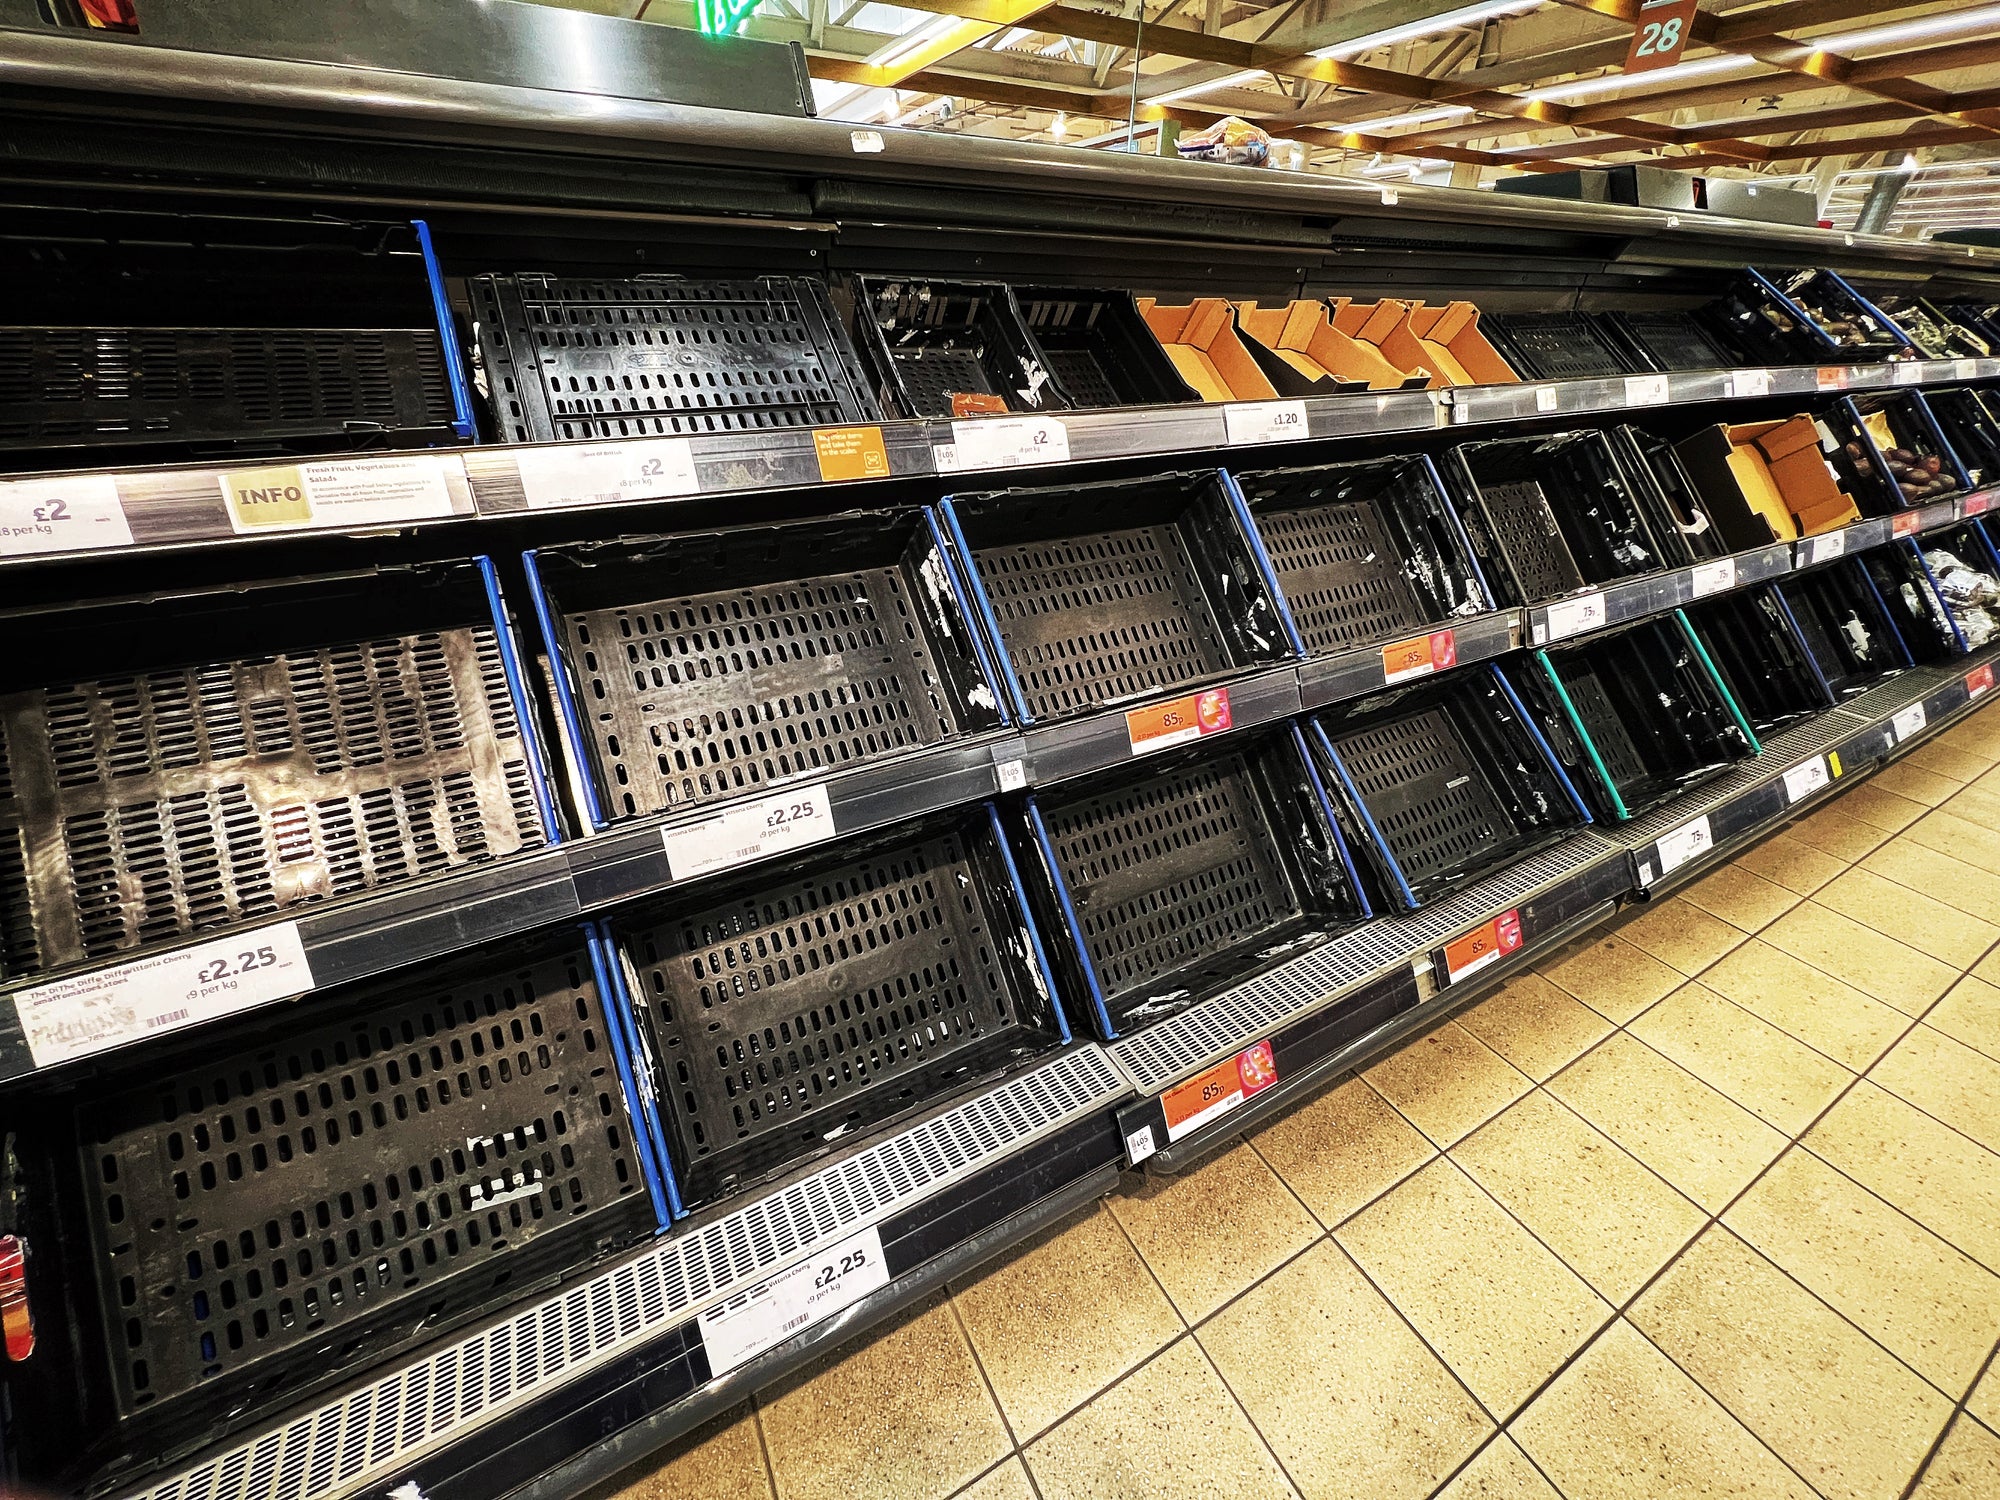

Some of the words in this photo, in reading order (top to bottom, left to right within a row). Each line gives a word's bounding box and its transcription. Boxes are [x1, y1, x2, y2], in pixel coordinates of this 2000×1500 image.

[1636, 17, 1683, 58] 28
[1274, 413, 1298, 425] £1.20
[1033, 431, 1048, 444] £2
[641, 458, 664, 476] £2
[238, 486, 301, 505] INFO
[33, 498, 72, 521] £2
[12, 527, 33, 537] per
[35, 524, 52, 535] kg
[1163, 712, 1183, 728] 85p
[767, 801, 814, 827] £2.25
[768, 827, 780, 837] per
[781, 825, 790, 834] kg
[198, 946, 277, 984] £2.25
[30, 991, 47, 1000] The
[162, 953, 192, 964] Cherry
[200, 985, 220, 998] per
[222, 980, 238, 990] kg
[1203, 1082, 1225, 1101] 85p
[791, 1263, 811, 1276] Cherry
[815, 1249, 866, 1289] £2.25
[816, 1289, 829, 1300] per
[830, 1283, 841, 1291] kg
